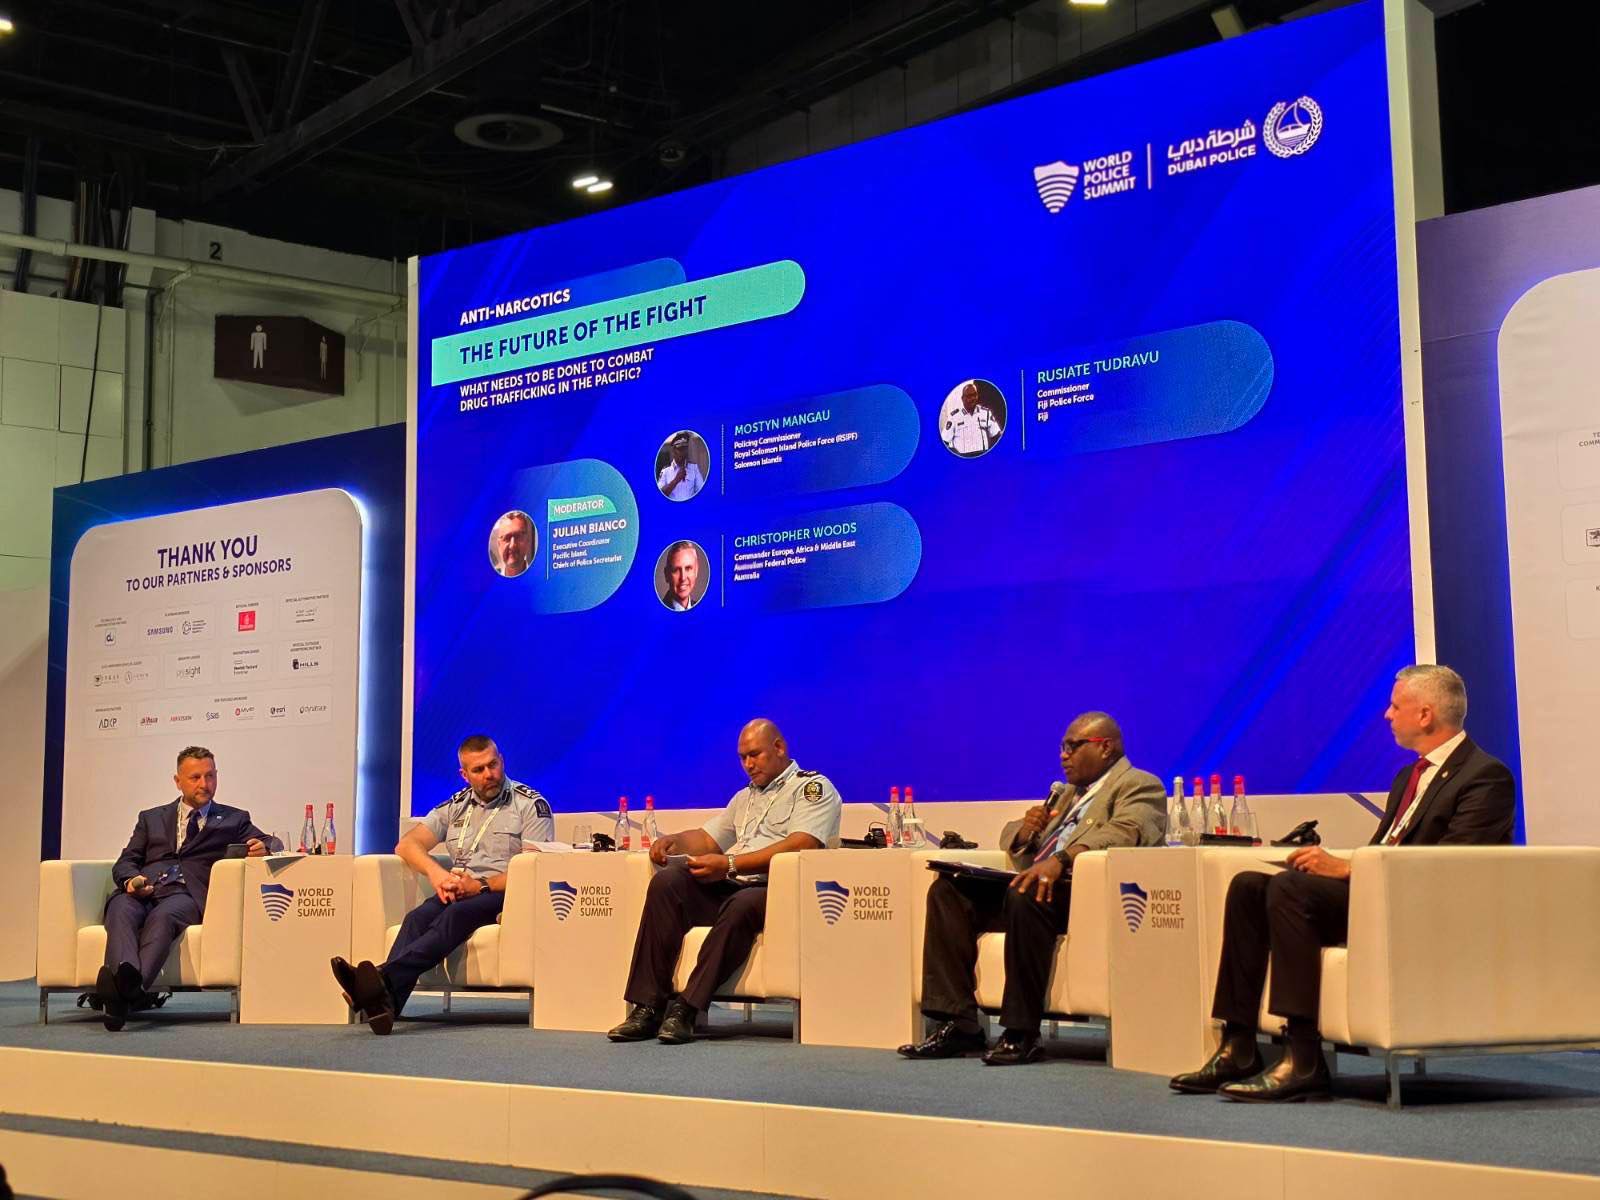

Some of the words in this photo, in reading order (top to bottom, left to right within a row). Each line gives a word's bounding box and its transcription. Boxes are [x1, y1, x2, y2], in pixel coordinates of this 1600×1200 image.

[1206, 119, 1256, 149] شرطة
[1168, 137, 1205, 161] دبي
[1083, 151, 1132, 172] WORLD
[1168, 156, 1206, 175] DUBAI
[1209, 144, 1256, 165] POLICE
[1084, 164, 1129, 186] POLICE
[1084, 176, 1136, 200] SUMMIT
[210, 242, 222, 261] 2
[460, 288, 571, 325] ANTI-NARCOTICS
[460, 342, 494, 364] THE
[499, 326, 569, 357] FUTURE
[574, 319, 598, 342] OF
[603, 310, 641, 335] THE
[647, 295, 707, 326] FIGHT
[460, 381, 490, 397] WHAT
[491, 375, 523, 391] NEEDS
[525, 371, 540, 384] TO
[542, 368, 554, 381] BE
[557, 361, 588, 379] DONE
[590, 359, 605, 372] TO
[607, 348, 654, 368] COMBAT
[1037, 362, 1090, 383] RUSIATE
[1094, 350, 1159, 373] TUDRAVU
[460, 397, 488, 412] DRUG
[490, 383, 556, 406] TRAFFICKING
[558, 380, 570, 394] IN
[572, 375, 593, 390] THE
[595, 367, 642, 386] PACIFIC?
[1037, 383, 1090, 398] Commissioner
[1037, 400, 1048, 410] Fiji
[1049, 397, 1072, 407] Police
[1073, 393, 1094, 403] Force
[734, 417, 780, 436] MOSTYN
[782, 409, 830, 428] MANGAU
[734, 439, 758, 449] Policing
[758, 432, 802, 445] Commissioner
[734, 450, 750, 460] Royal
[751, 446, 778, 456] Solomon
[778, 443, 797, 452] Island
[798, 439, 817, 449] Police
[817, 436, 836, 446] Force
[734, 460, 760, 470] Solomon
[761, 456, 783, 465] Islands
[553, 499, 604, 516] MODERATOR
[552, 523, 587, 539] JULIAN
[588, 518, 627, 533] BIANCO
[734, 528, 810, 548] CHRISTOPHER
[813, 522, 857, 538] WOODS
[157, 540, 216, 569] THANK
[221, 535, 258, 560] YOU
[552, 551, 570, 560] Pacific
[734, 551, 771, 561] Commander
[796, 544, 814, 554] Africa
[814, 543, 820, 552] &
[820, 541, 842, 551] Middle
[842, 540, 856, 549] East
[552, 561, 569, 570] Chiefs
[569, 560, 576, 568] of
[576, 559, 593, 567] Police
[764, 558, 787, 568] Federal
[787, 556, 806, 565] Police
[126, 578, 140, 592] TO
[142, 575, 164, 590] OUR
[167, 567, 220, 587] PARTNERS
[222, 566, 230, 580] &
[232, 557, 292, 578] SPONSORS
[297, 888, 334, 897] WORLD
[580, 886, 611, 895] WORLD
[853, 886, 890, 896] WORLD
[1150, 889, 1182, 901] WORLD
[297, 898, 331, 907] POLICE
[580, 897, 609, 906] POLICE
[853, 898, 889, 908] POLICE
[1151, 903, 1180, 915] POLICE
[297, 908, 336, 917] SUMMIT
[580, 907, 613, 917] SUMMIT
[853, 910, 893, 920] SUMMIT
[1151, 917, 1184, 928] SUMMIT
